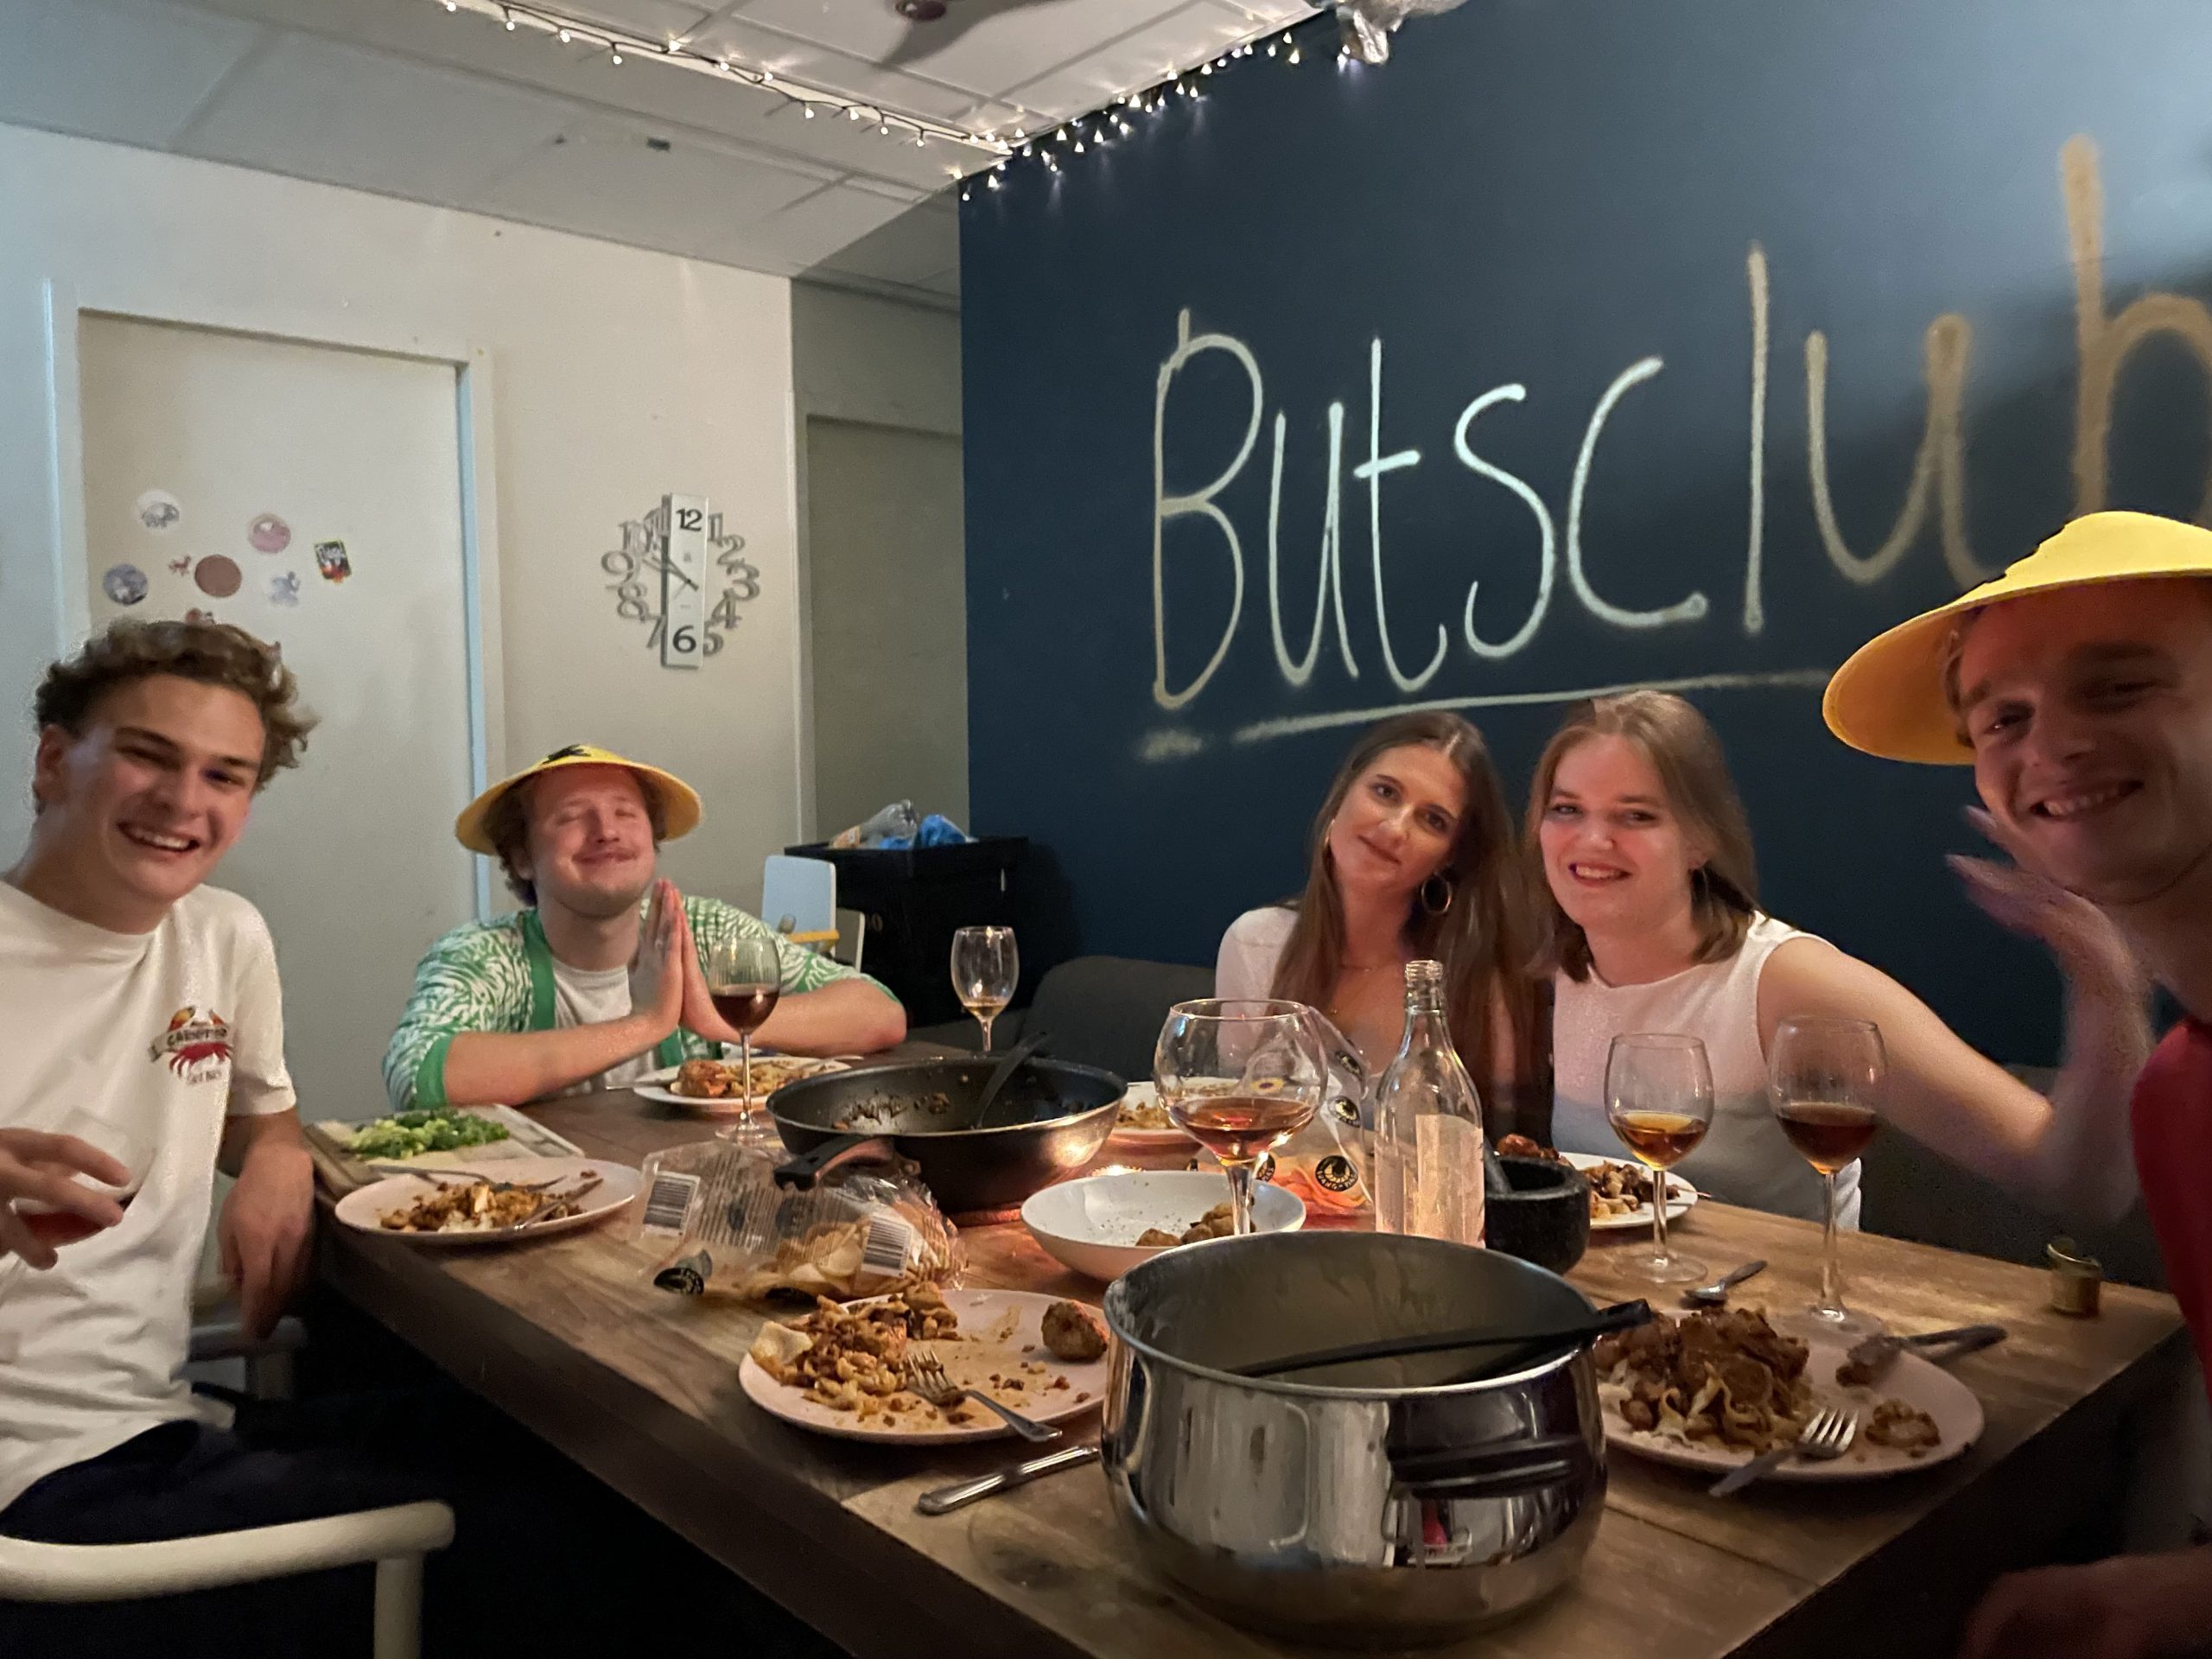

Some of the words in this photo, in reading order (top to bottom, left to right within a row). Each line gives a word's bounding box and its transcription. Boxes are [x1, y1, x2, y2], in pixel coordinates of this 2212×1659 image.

[676, 508, 703, 532] 12
[716, 534, 746, 565] 2
[601, 550, 639, 589] 9
[726, 559, 760, 601] 3
[616, 582, 649, 621] 8
[710, 588, 743, 629] 4
[672, 625, 696, 653] 6
